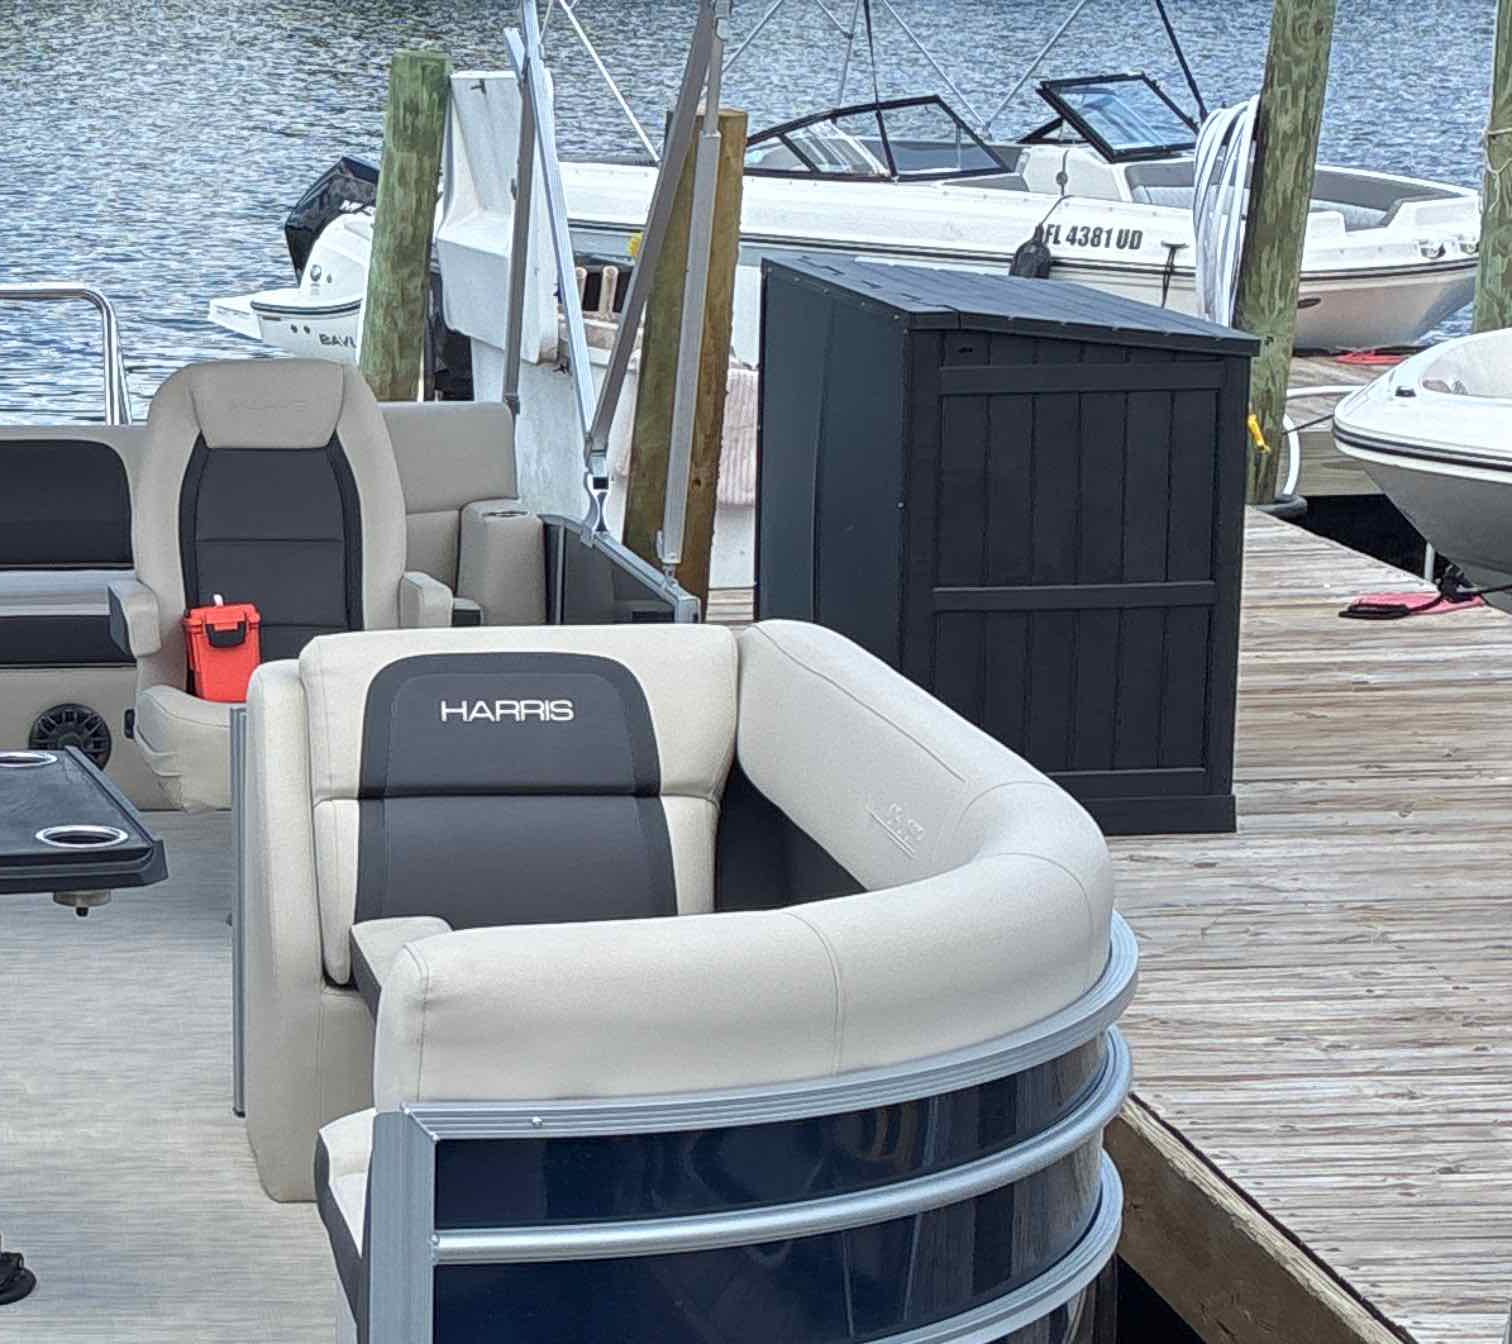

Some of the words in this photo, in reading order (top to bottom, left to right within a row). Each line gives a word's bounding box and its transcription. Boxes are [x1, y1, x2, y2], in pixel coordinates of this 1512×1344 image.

[1044, 223, 1062, 245] FL
[1065, 225, 1113, 249] 4381
[1116, 228, 1144, 250] UD
[440, 699, 575, 722] HARRIS
